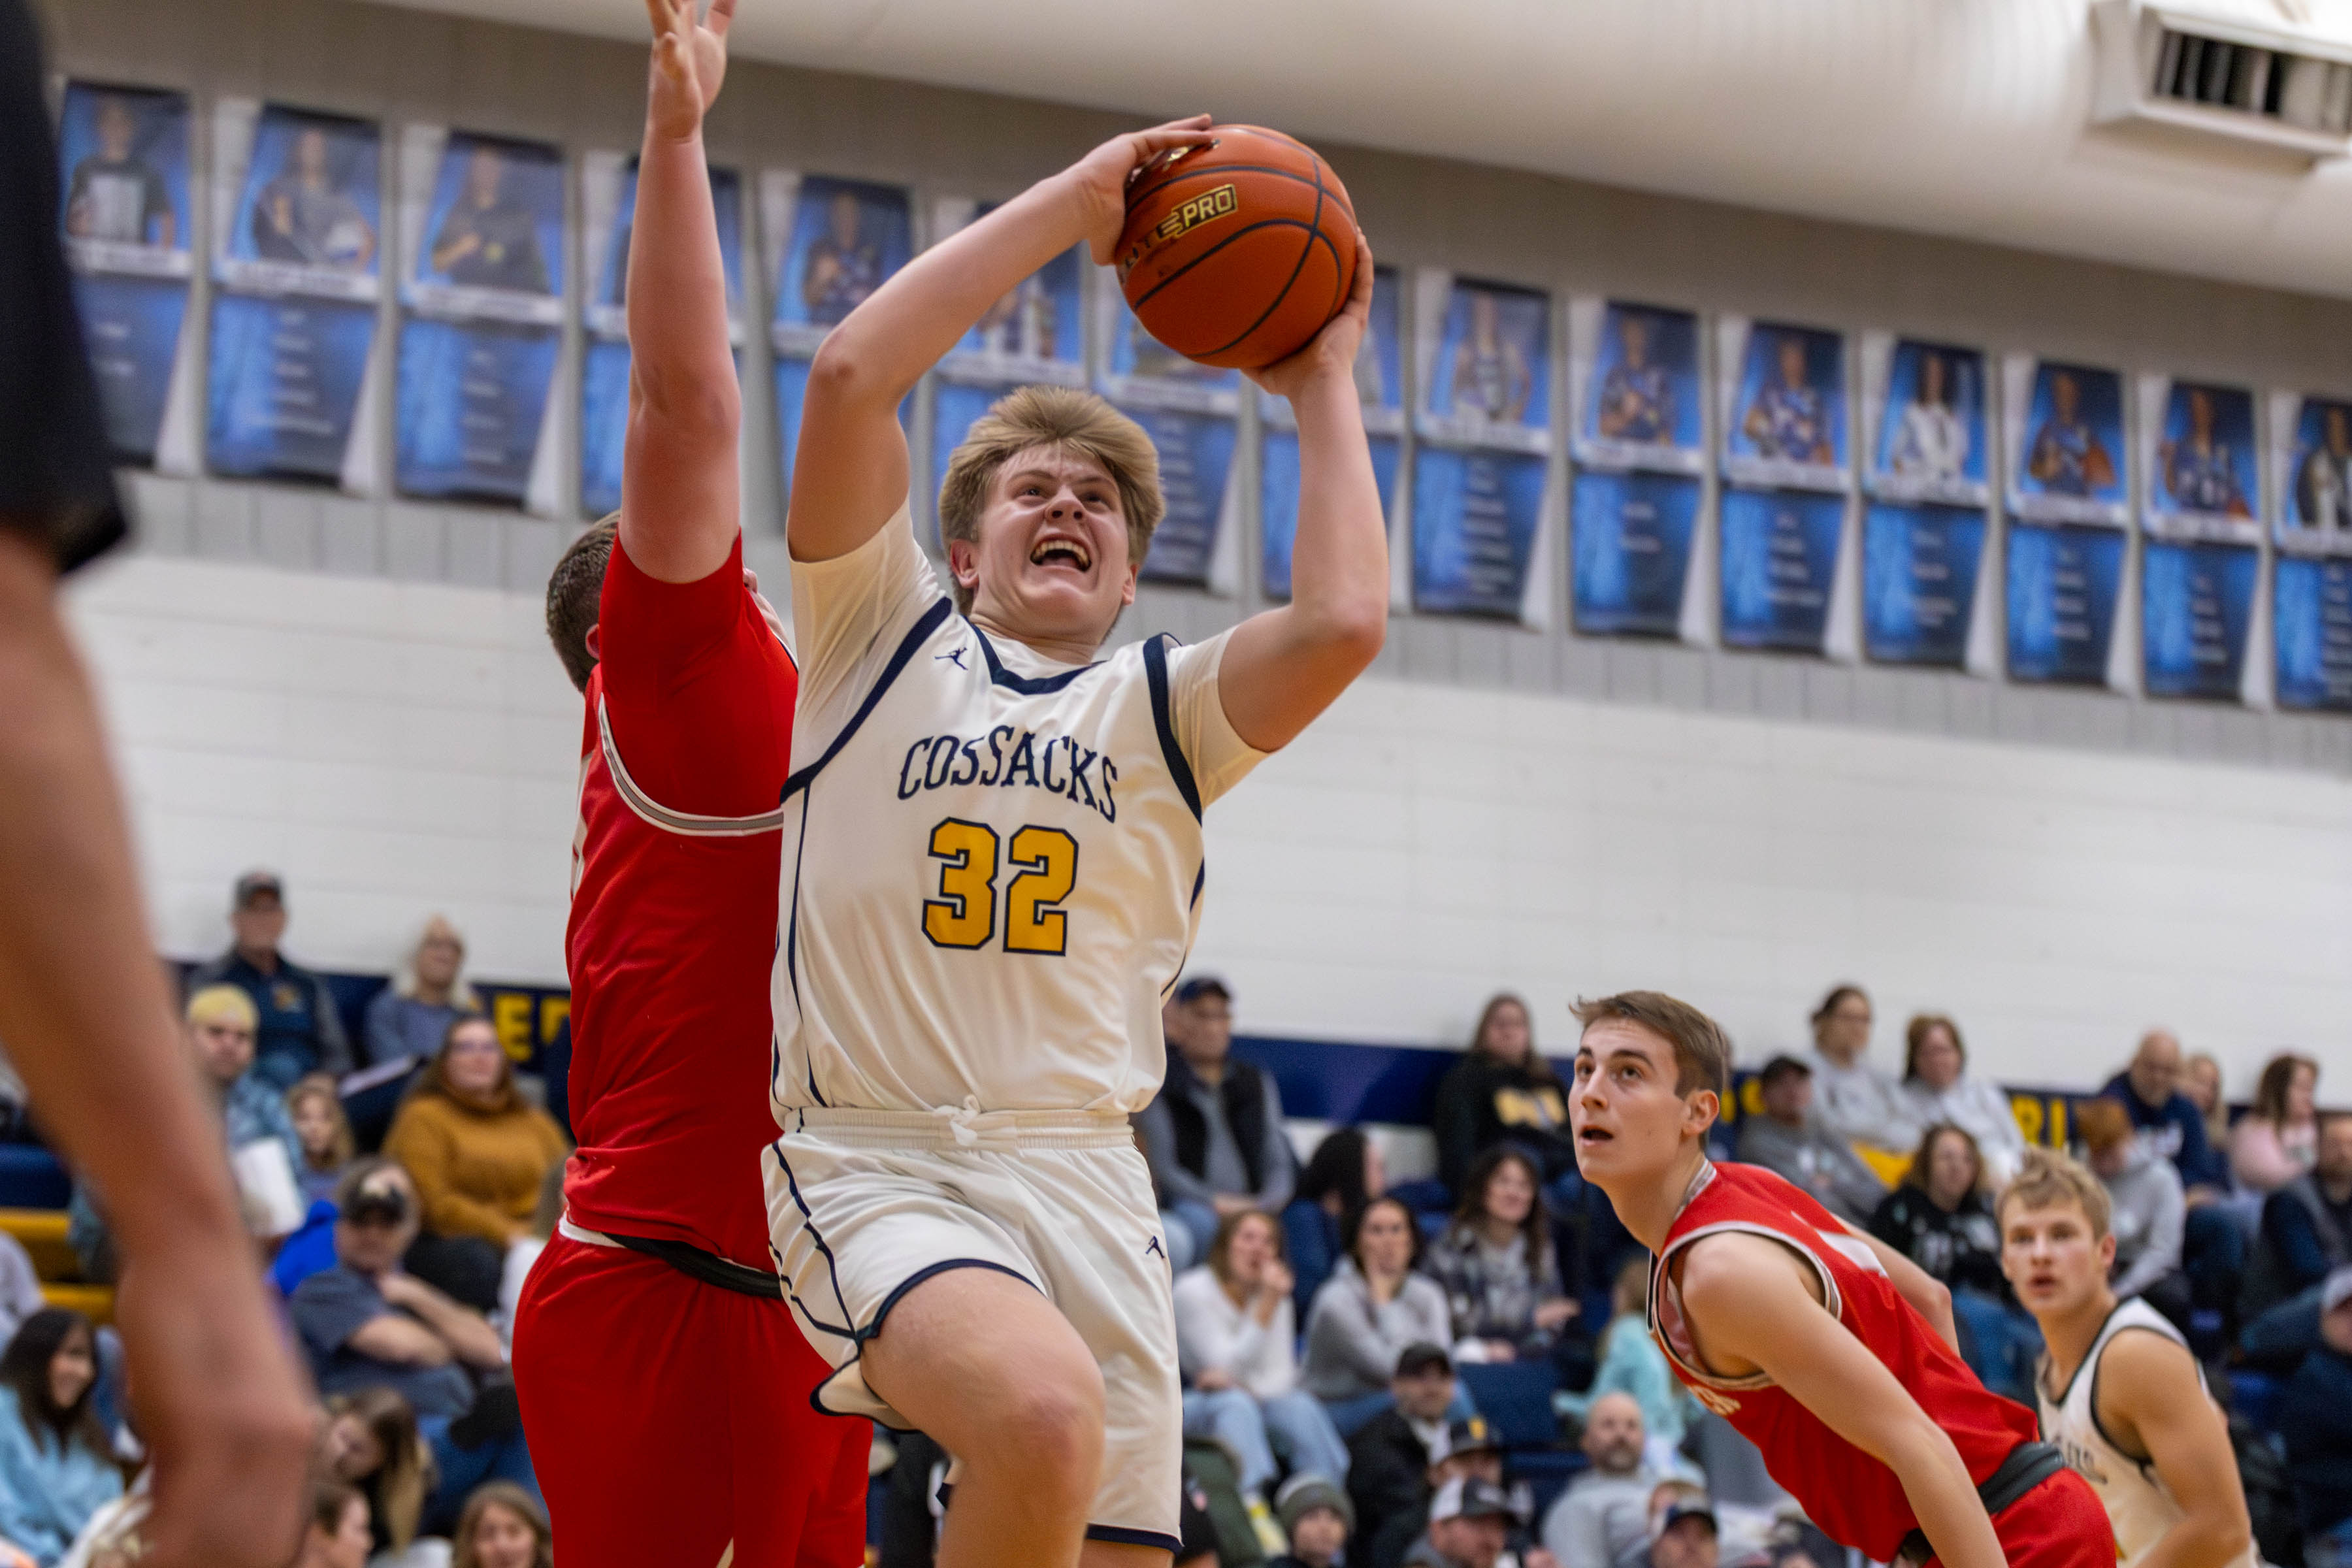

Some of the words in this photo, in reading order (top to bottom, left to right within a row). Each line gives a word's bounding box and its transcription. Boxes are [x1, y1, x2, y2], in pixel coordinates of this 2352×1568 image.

[1183, 189, 1233, 227] PRO
[897, 725, 1118, 824] COSSACKS
[921, 816, 1079, 956] 32
